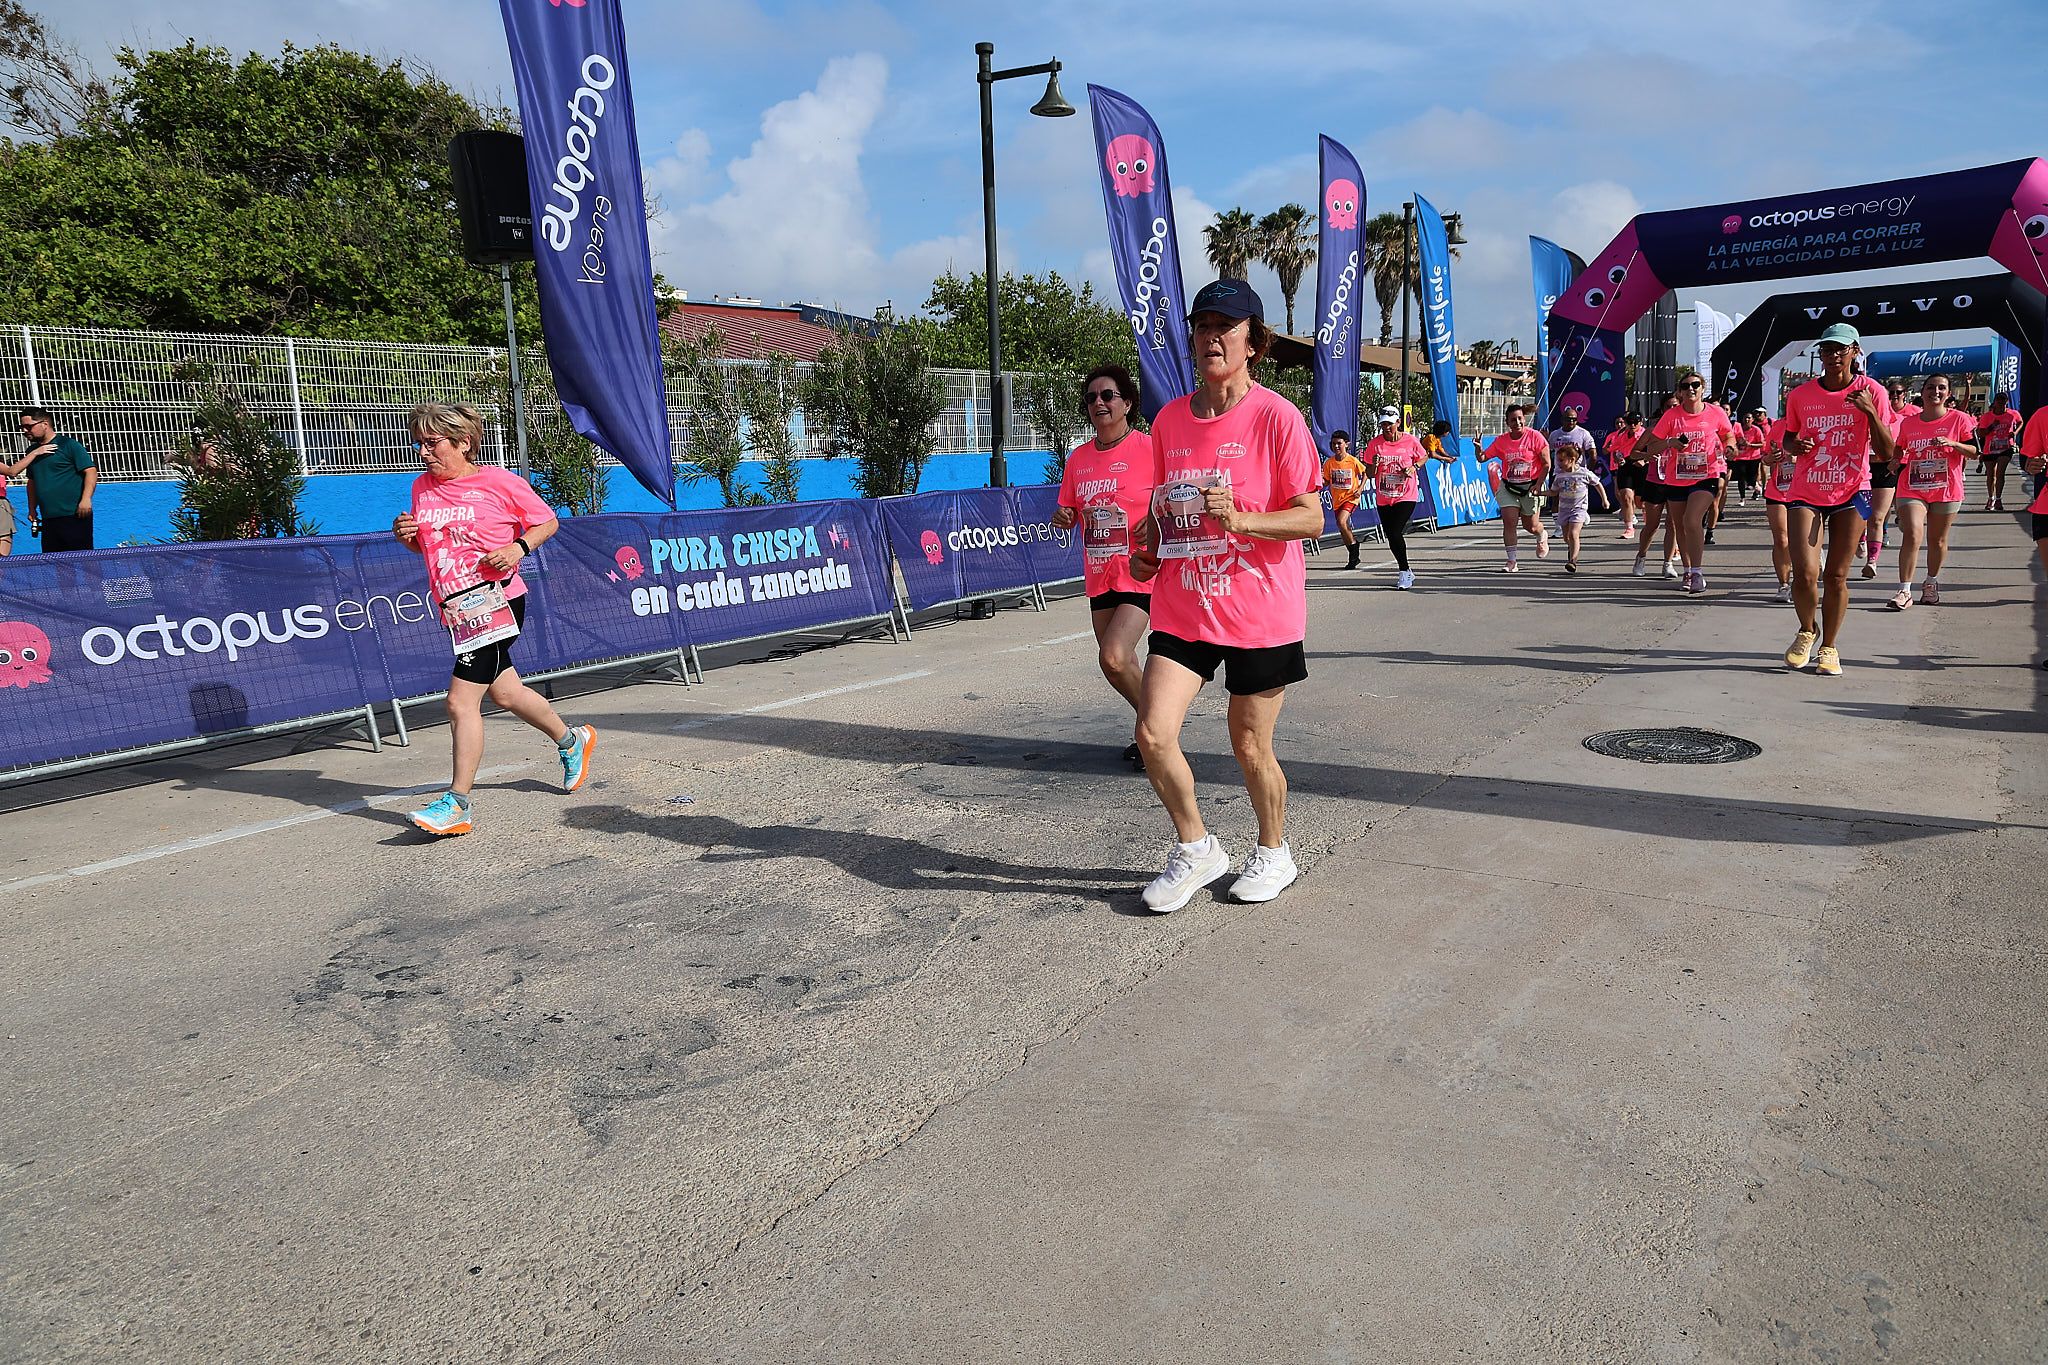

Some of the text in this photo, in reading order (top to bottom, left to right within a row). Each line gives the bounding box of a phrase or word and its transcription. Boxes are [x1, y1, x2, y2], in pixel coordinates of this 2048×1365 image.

[1749, 195, 1916, 228] octopus energy
[1708, 222, 1922, 257] LA ENERGÍA PARA CORRER
[1707, 237, 1925, 271] A LA VELOCIDAD DE LA LUZ
[1803, 294, 1973, 320] VOLVO
[1908, 350, 1964, 373] Marlene
[1806, 414, 1855, 428] CARRERA
[1677, 431, 1705, 441] CRRERA
[1907, 438, 1933, 449] CARRE
[1167, 448, 1192, 458] OYSHO
[1827, 456, 1840, 471] LA
[1807, 470, 1846, 483] MUJER
[1076, 478, 1117, 498] CARRERA
[1169, 490, 1198, 499] ASTURIANA
[1435, 462, 1490, 525] Marlene
[417, 505, 476, 524] CARRERA
[1175, 514, 1201, 528] 016
[1093, 528, 1110, 538] 016
[650, 525, 821, 575] PURA CHISPA
[631, 558, 852, 617] en cada zancada
[81, 590, 434, 665] octopus ener
[469, 613, 493, 628] 016
